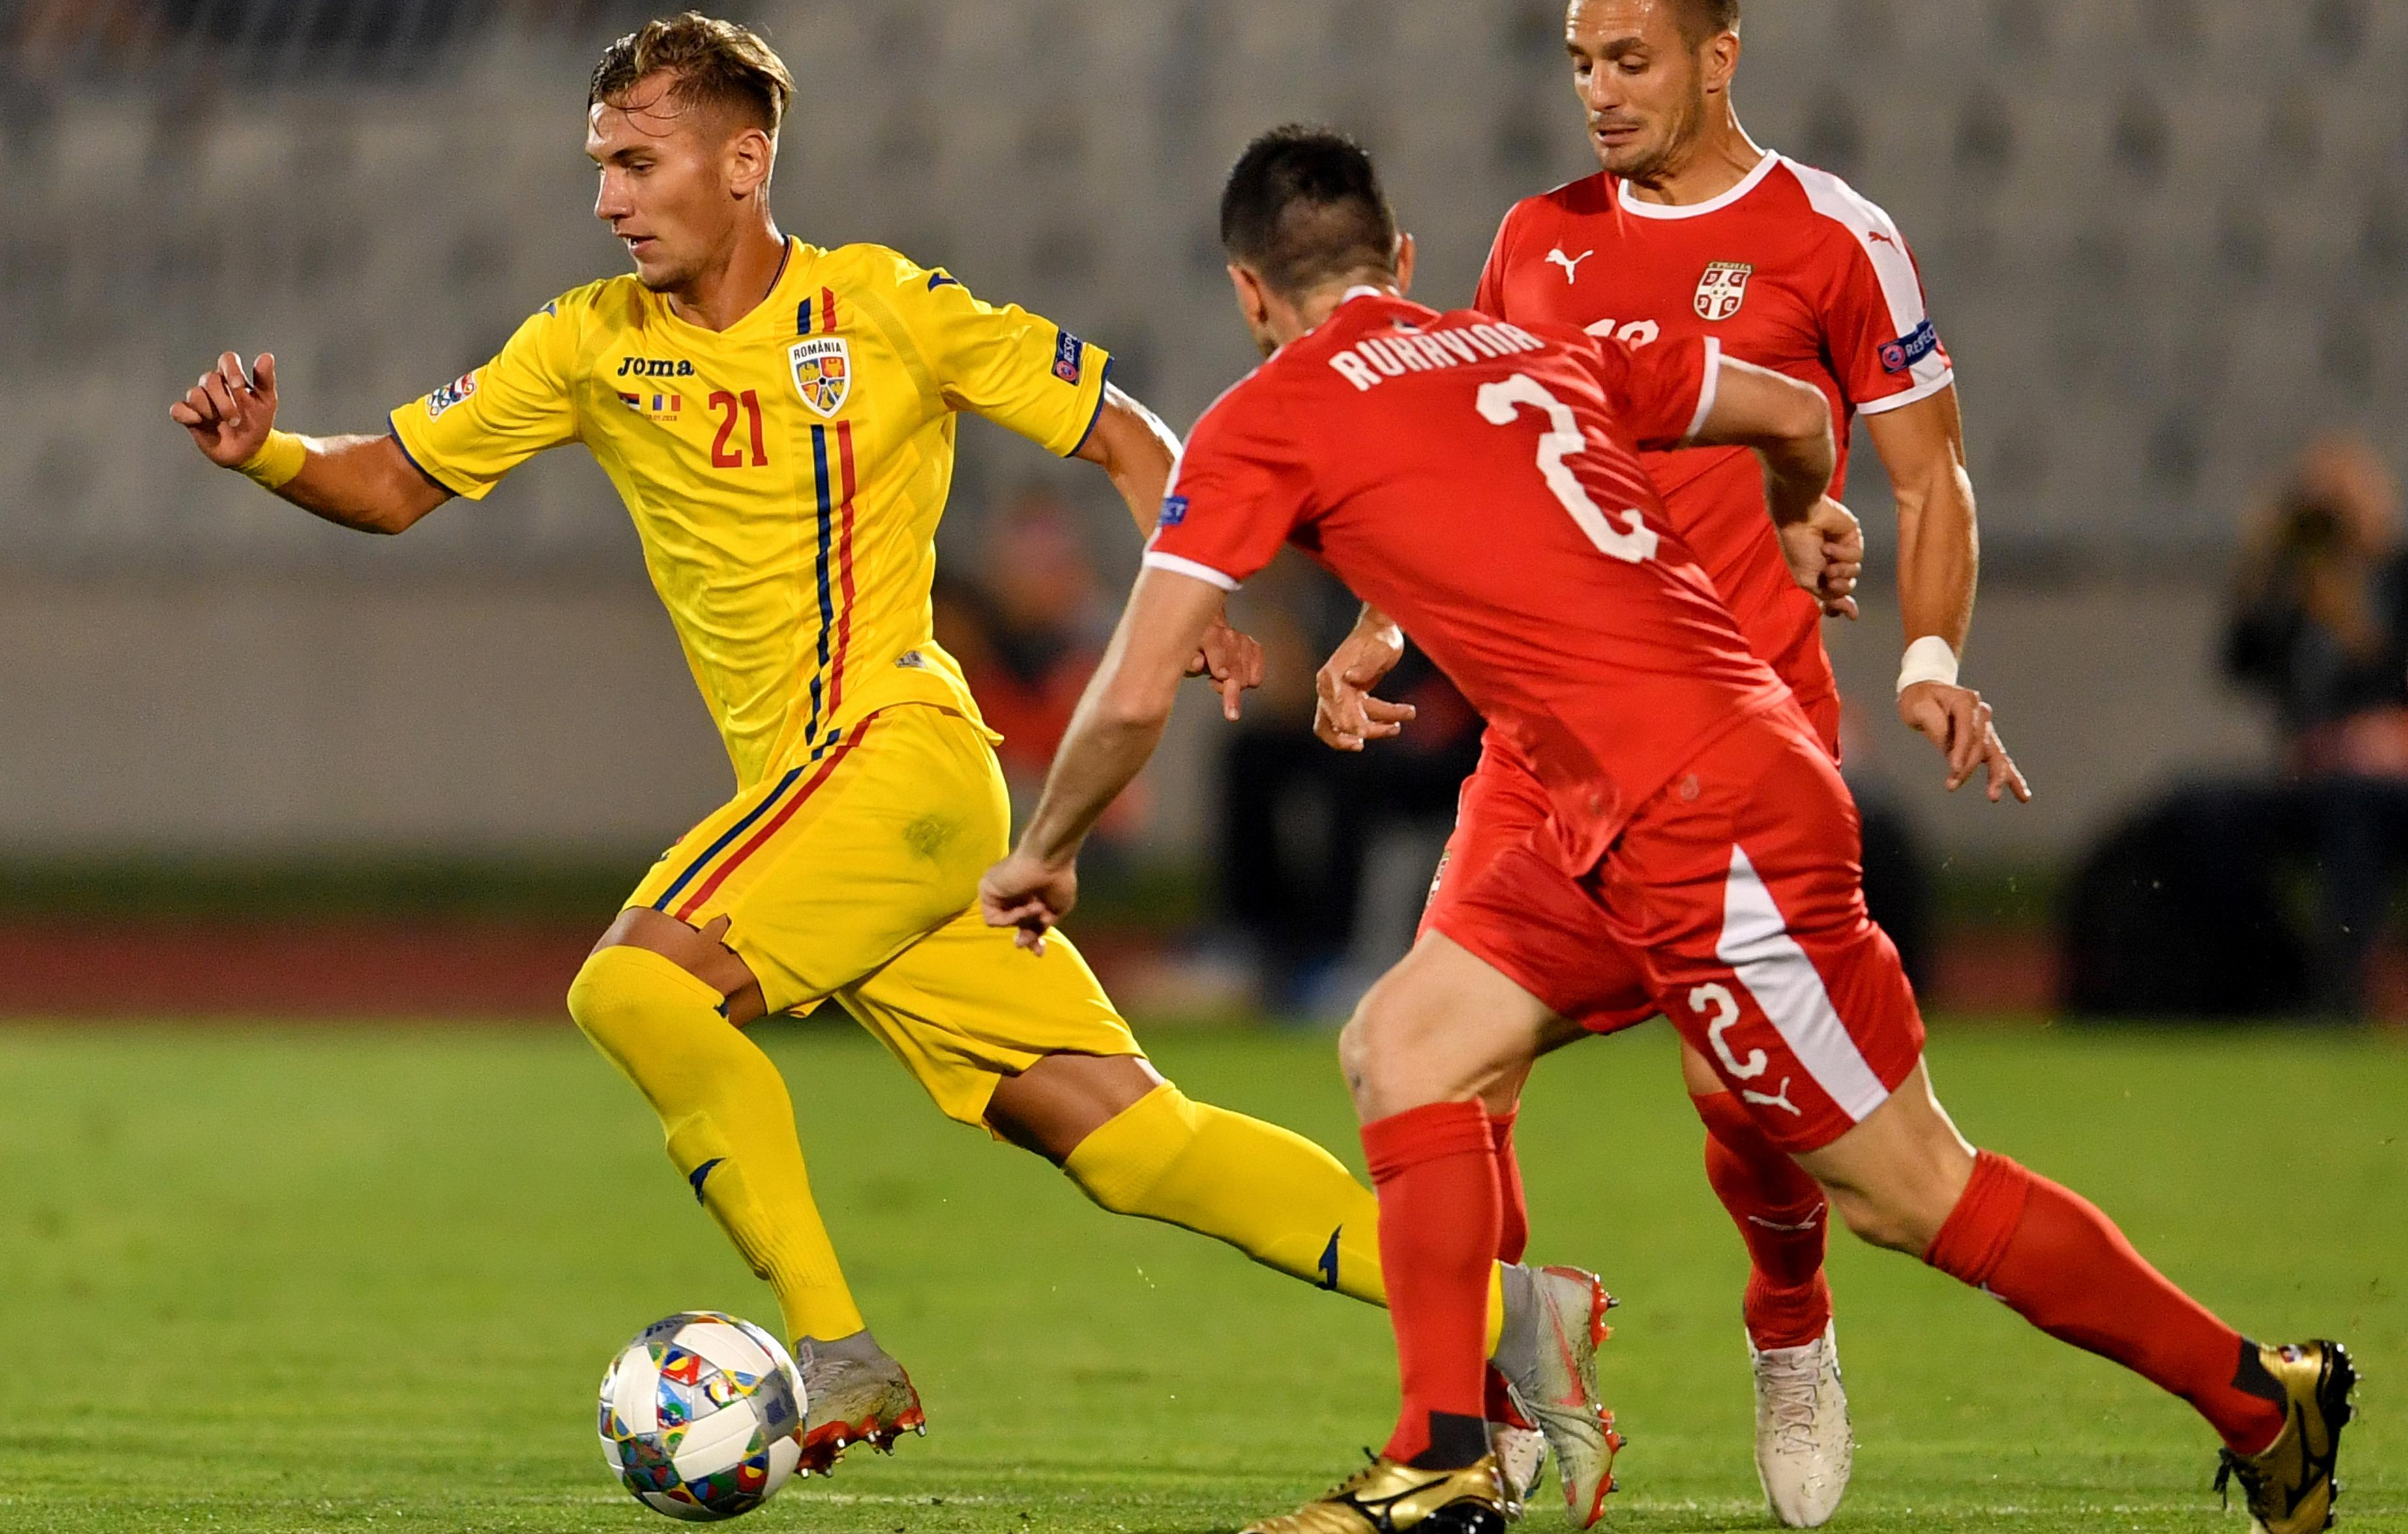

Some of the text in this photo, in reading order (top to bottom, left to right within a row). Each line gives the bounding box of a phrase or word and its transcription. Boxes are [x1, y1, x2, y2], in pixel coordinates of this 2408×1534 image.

[1329, 322, 1545, 391] RUKAVINA
[709, 389, 768, 468] 21
[1476, 373, 1658, 563] 2
[1687, 982, 1768, 1080] 2
